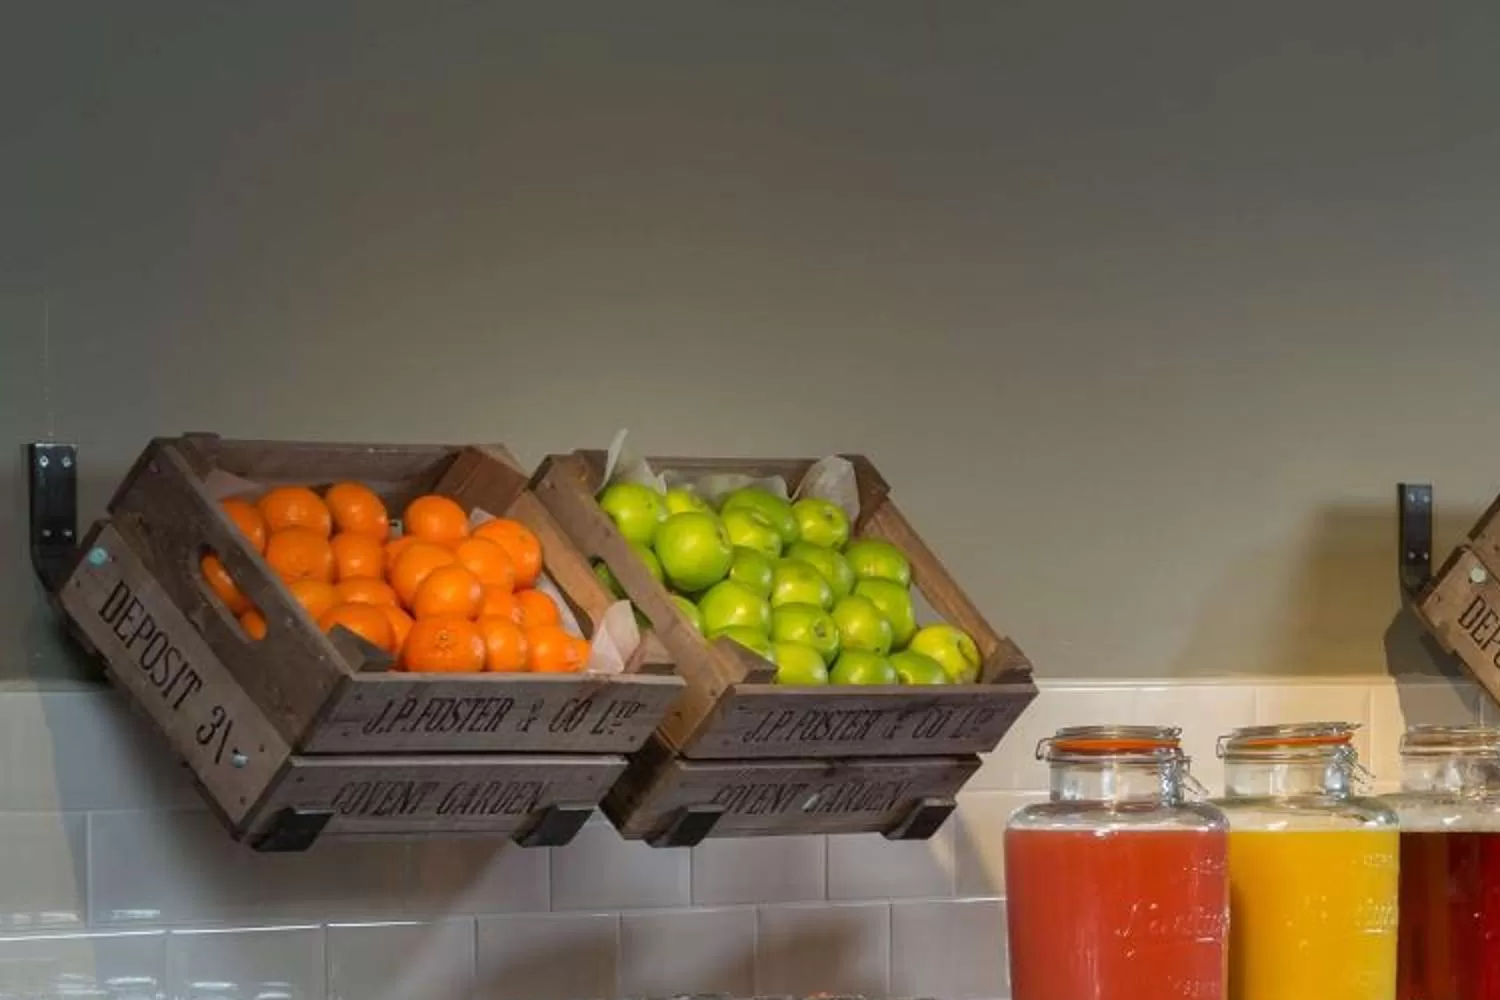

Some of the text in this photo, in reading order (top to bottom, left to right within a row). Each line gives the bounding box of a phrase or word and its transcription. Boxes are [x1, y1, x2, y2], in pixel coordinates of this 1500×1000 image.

[98, 580, 203, 710] DEPOSIT
[548, 698, 593, 734] CO
[330, 781, 553, 816] COVENT GARDEN
